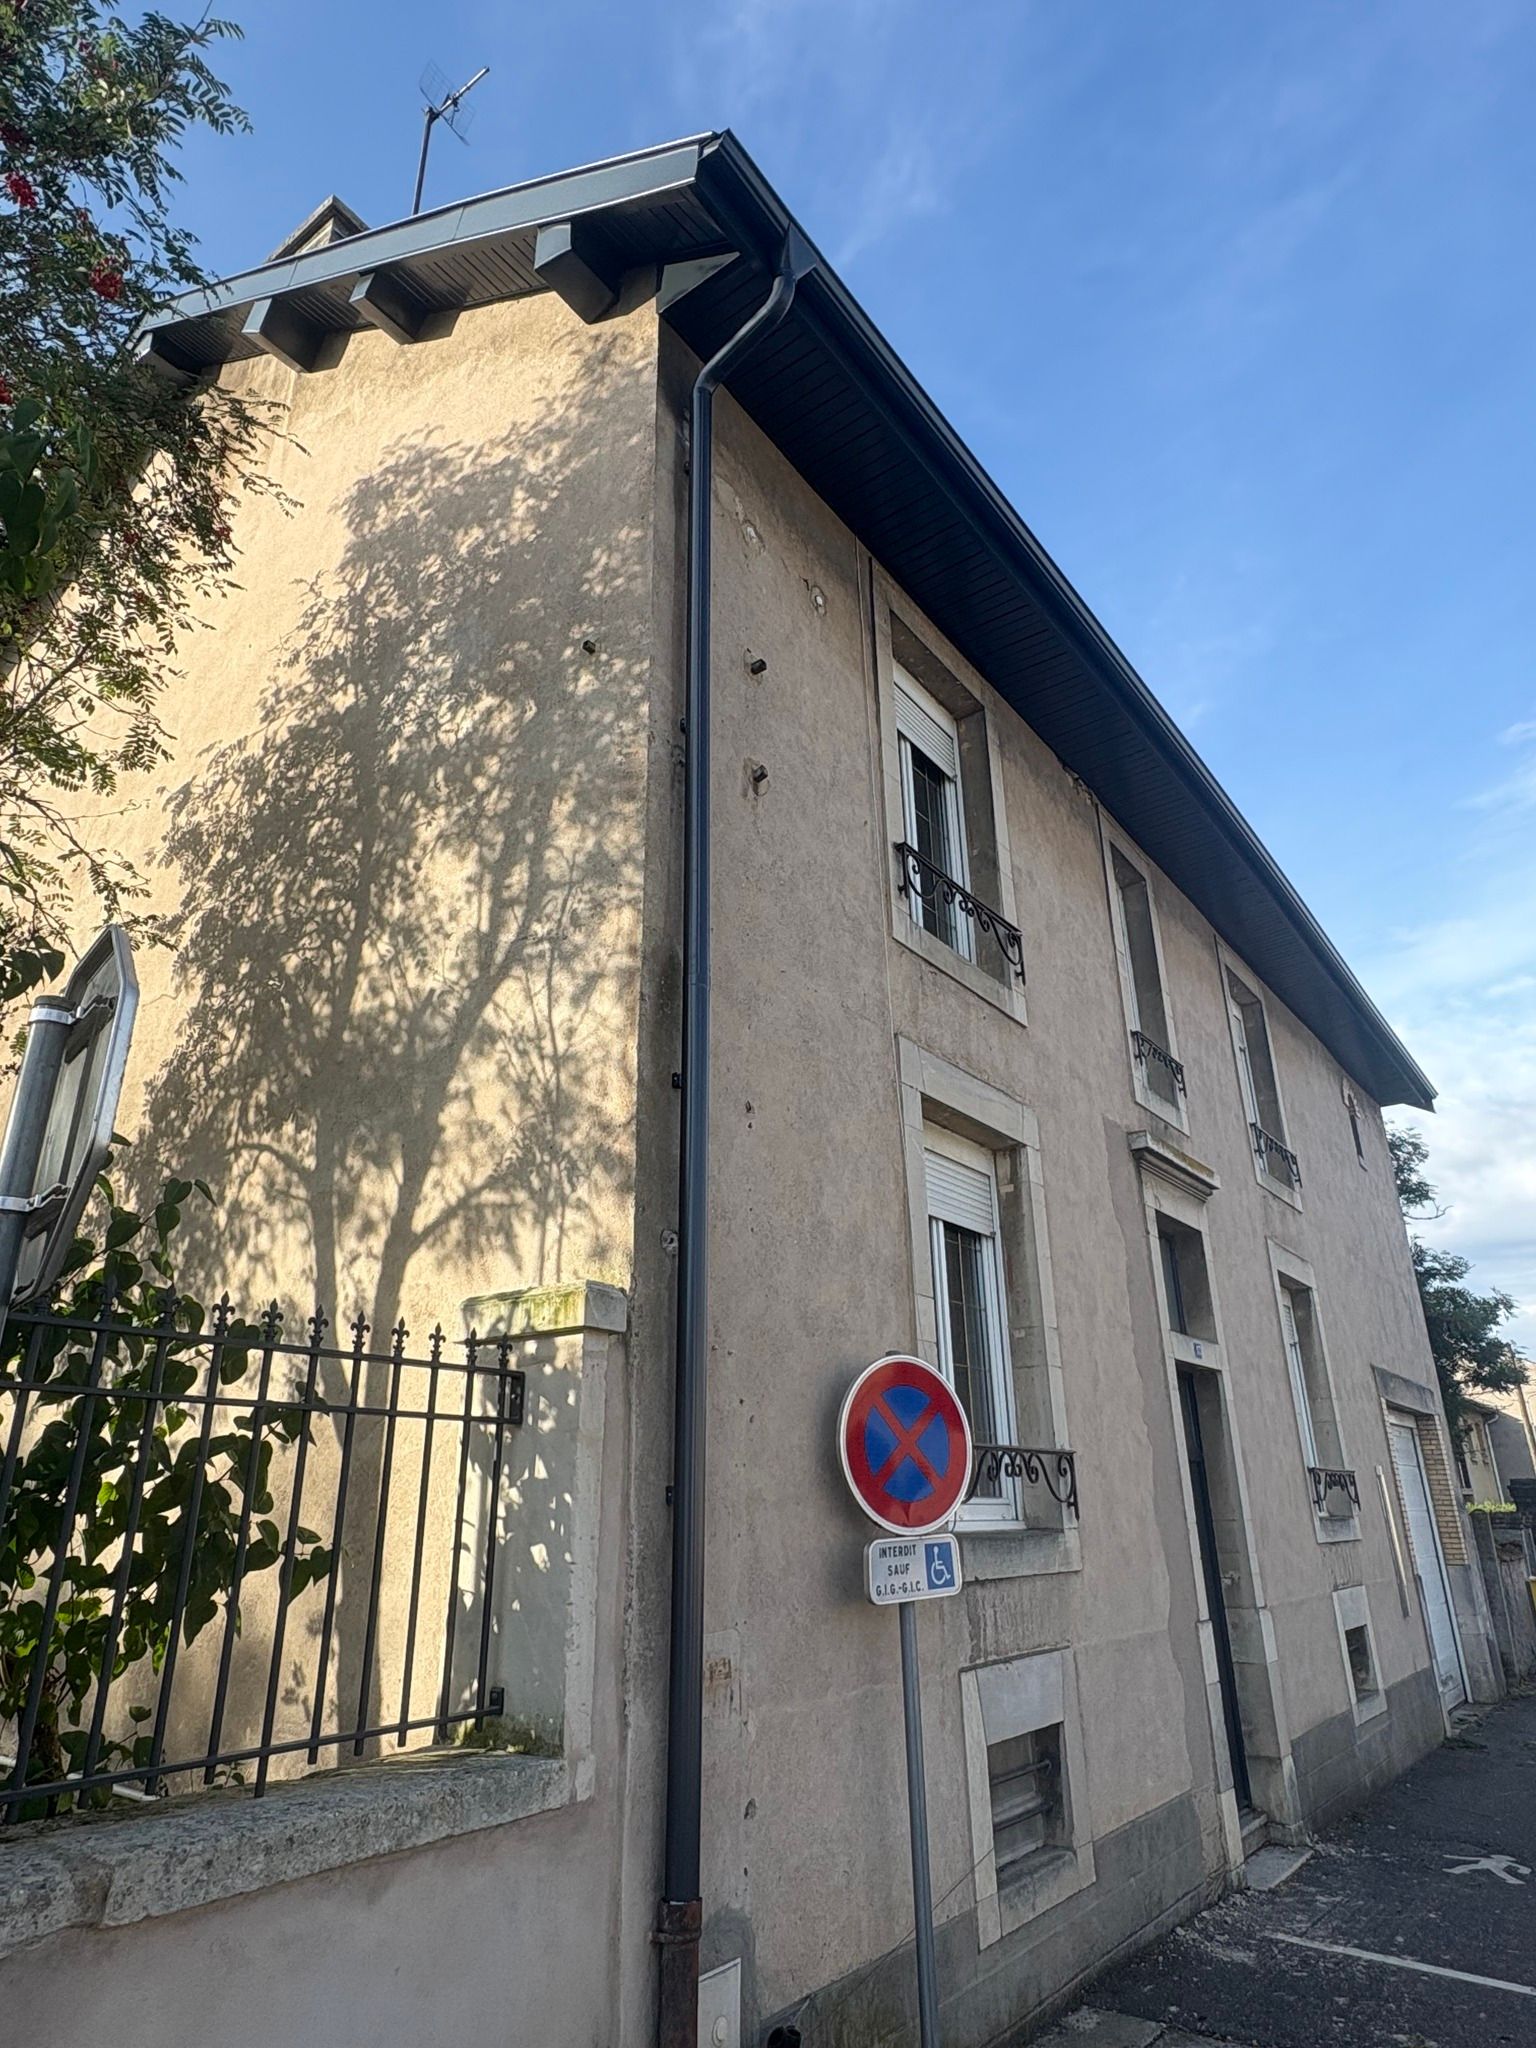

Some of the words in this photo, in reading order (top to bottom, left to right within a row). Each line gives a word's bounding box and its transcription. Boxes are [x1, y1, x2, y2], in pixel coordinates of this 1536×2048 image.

[879, 1544, 917, 1559] INTERDIT
[888, 1563, 910, 1576] SAUF
[876, 1581, 924, 1597] G.I.G.-G.I.C.
